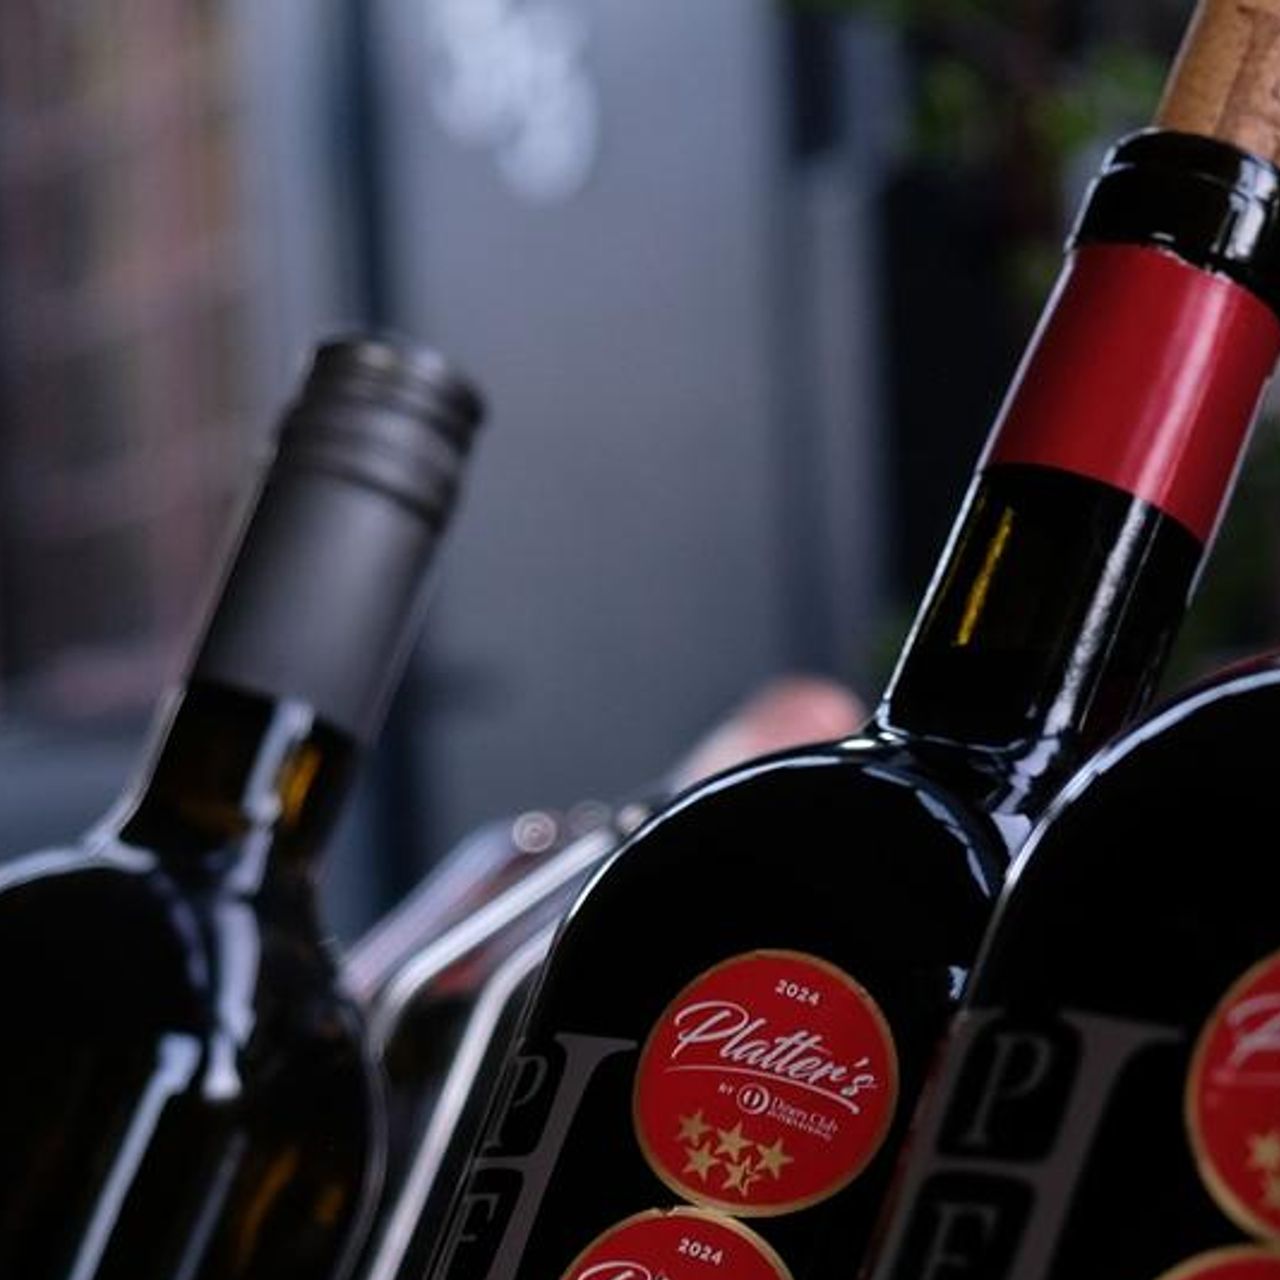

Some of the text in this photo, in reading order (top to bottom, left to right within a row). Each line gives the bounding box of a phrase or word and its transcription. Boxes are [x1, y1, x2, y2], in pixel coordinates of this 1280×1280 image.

[775, 978, 821, 1005] 2024
[672, 999, 878, 1097] Platter's
[677, 1237, 723, 1267] 2024
